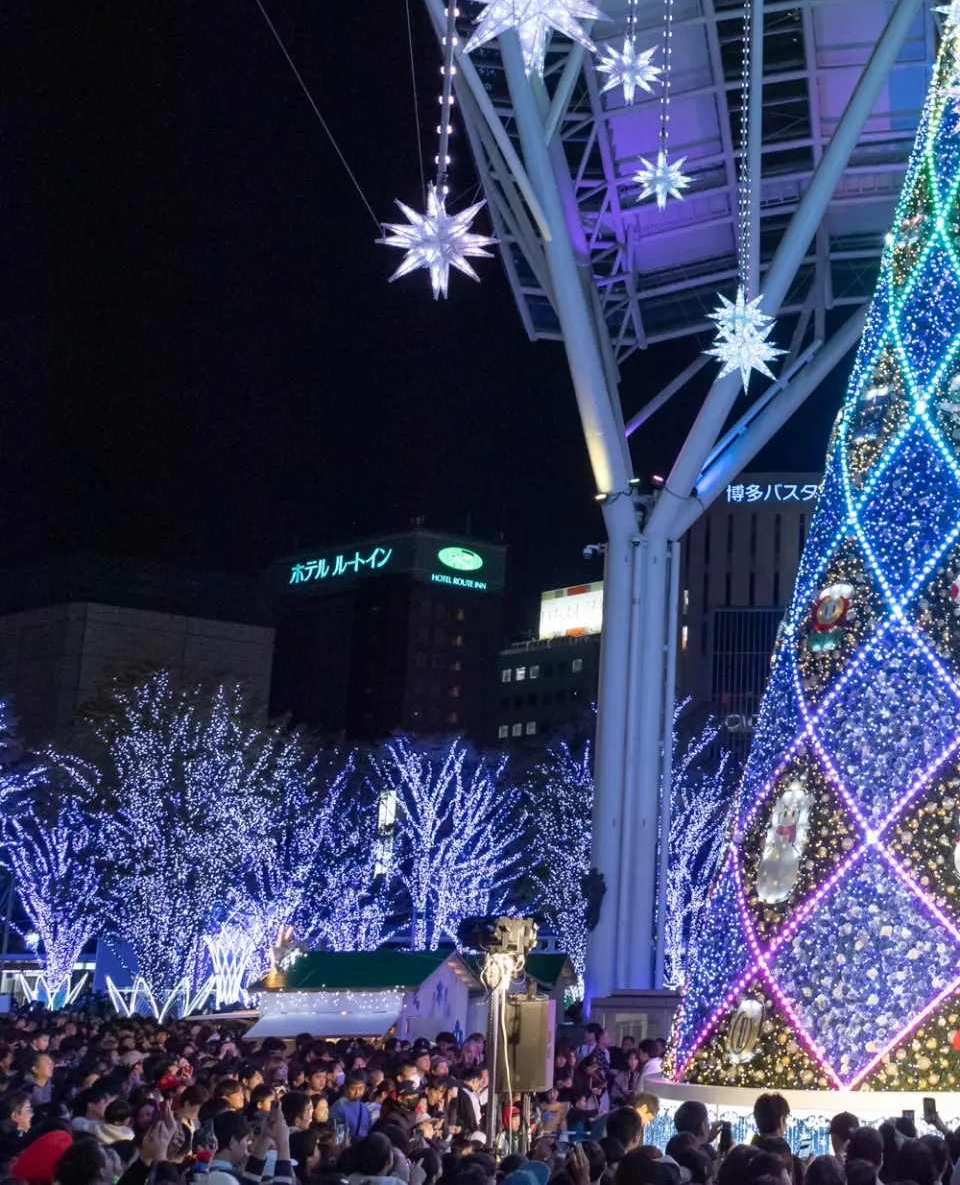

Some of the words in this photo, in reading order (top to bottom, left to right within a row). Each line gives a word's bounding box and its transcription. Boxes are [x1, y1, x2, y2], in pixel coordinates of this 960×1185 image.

[289, 558, 332, 585] ホテル
[333, 547, 393, 578] ルートイン
[431, 573, 452, 584] HOTEL
[453, 577, 474, 588] ROUTE
[474, 581, 487, 590] INN
